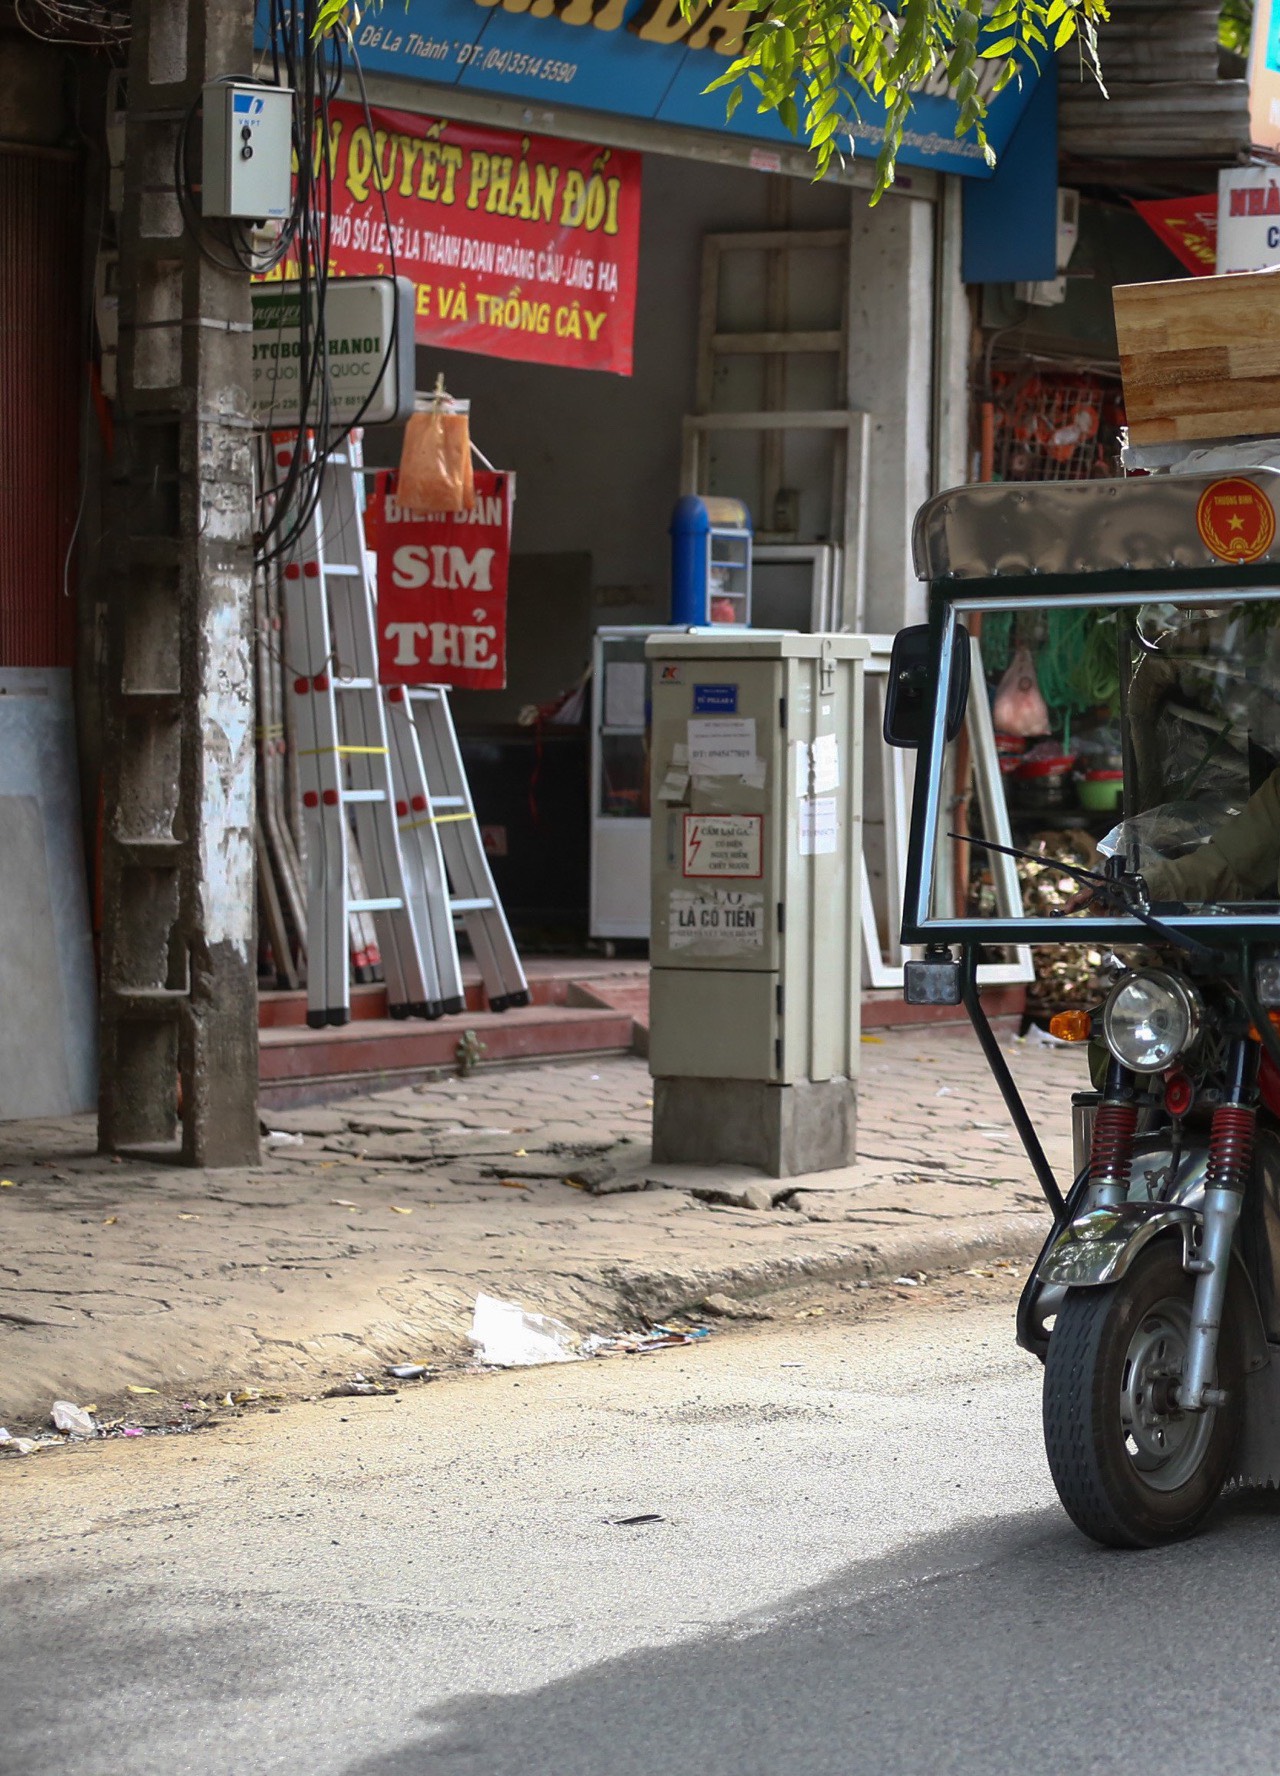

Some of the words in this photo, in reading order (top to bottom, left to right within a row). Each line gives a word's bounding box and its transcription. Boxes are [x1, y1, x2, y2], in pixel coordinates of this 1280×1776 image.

[381, 29, 402, 51] La
[541, 60, 578, 84] 5590
[238, 118, 261, 127] VNPT
[345, 119, 461, 210] QUYẾT
[466, 137, 557, 223] PHẢN
[559, 147, 621, 235] ĐỐI
[438, 282, 469, 322] VÀ
[475, 285, 550, 334] TRỒNG
[555, 301, 607, 341] CÂY
[328, 336, 381, 355] HANOI
[391, 545, 495, 592] SIM
[384, 609, 497, 670] THẺ
